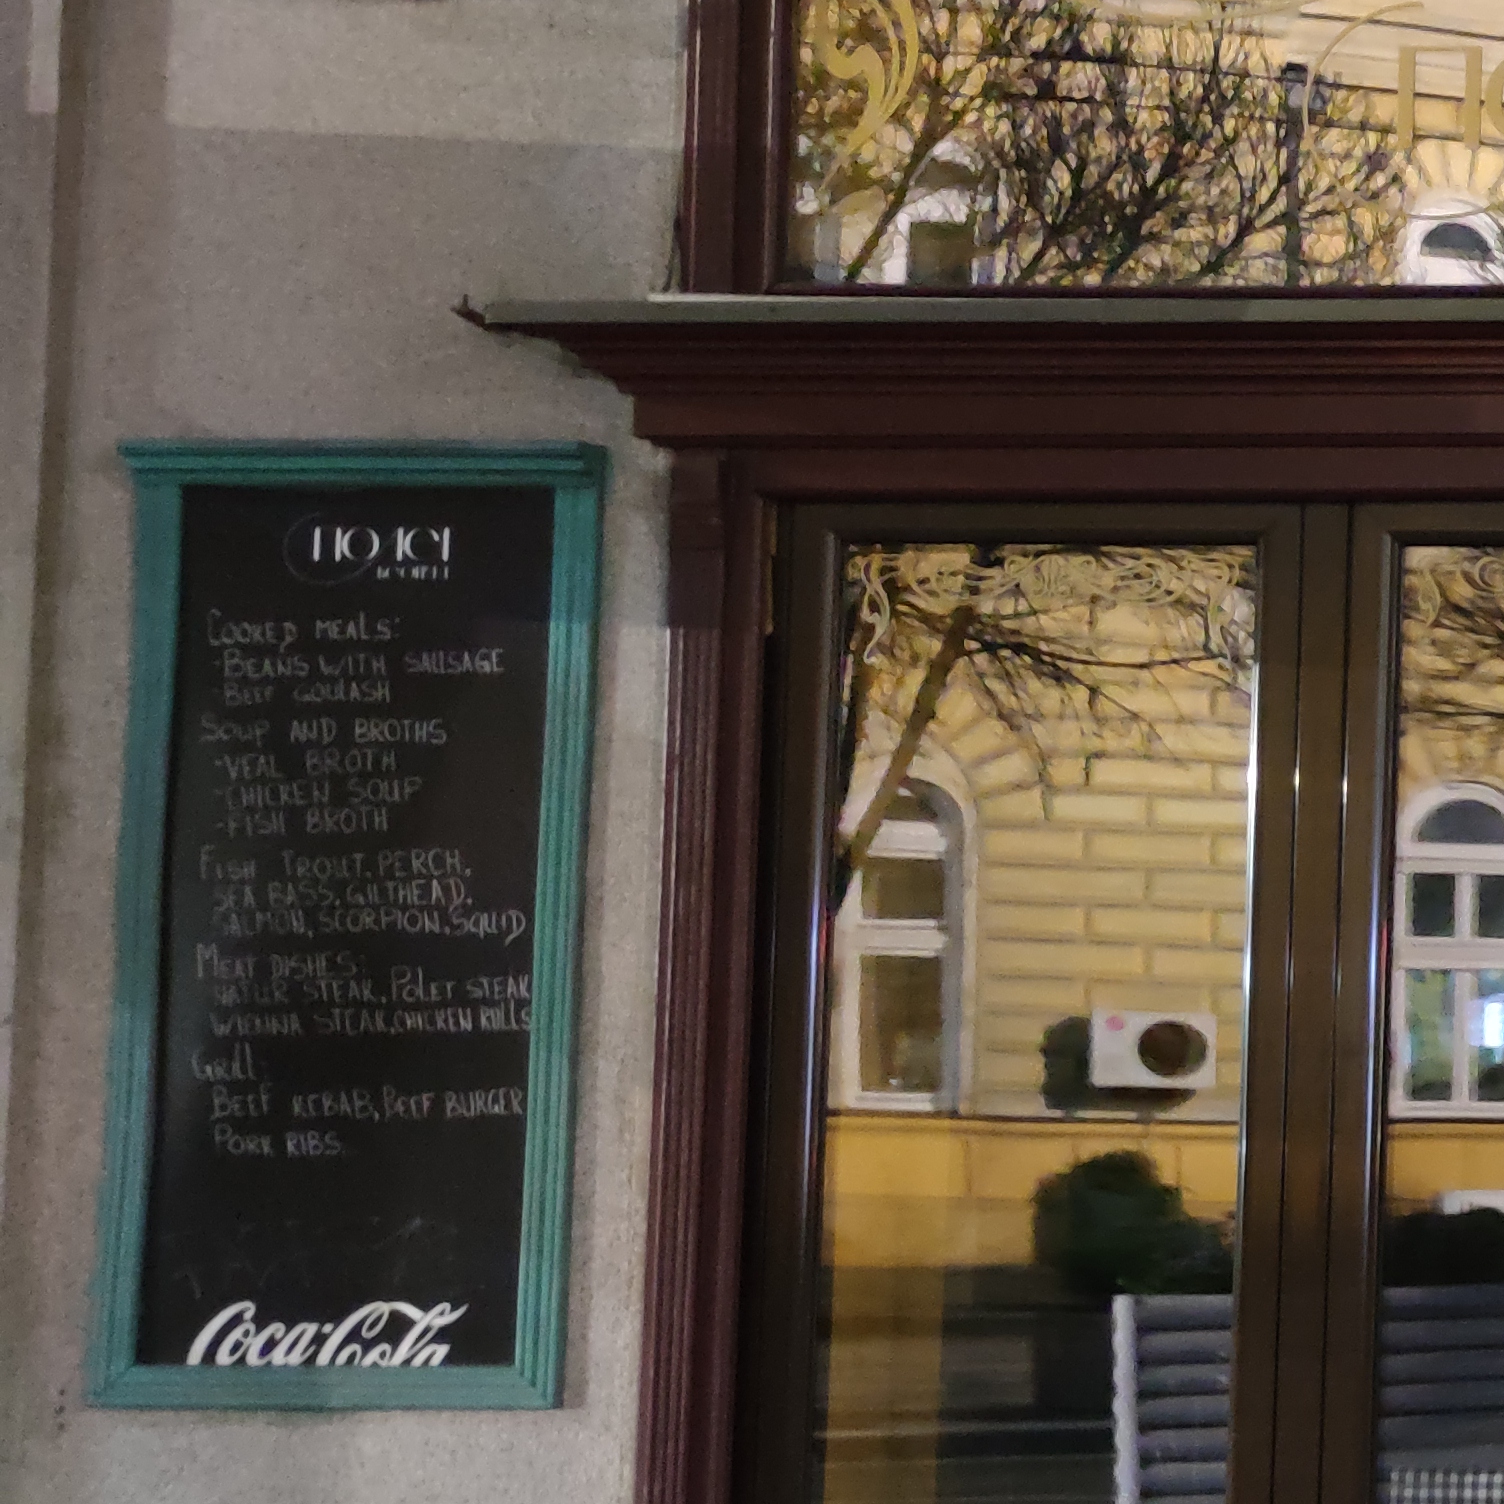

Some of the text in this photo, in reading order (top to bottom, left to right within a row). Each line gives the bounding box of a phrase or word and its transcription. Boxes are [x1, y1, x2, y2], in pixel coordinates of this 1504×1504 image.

[318, 653, 387, 676] WITH
[290, 717, 337, 744] AND
[354, 717, 447, 745] BROTHS
[305, 749, 396, 776] BROTH
[349, 776, 423, 804] SOUP
[307, 806, 389, 834] BROTH
[466, 973, 529, 1000] STEAK
